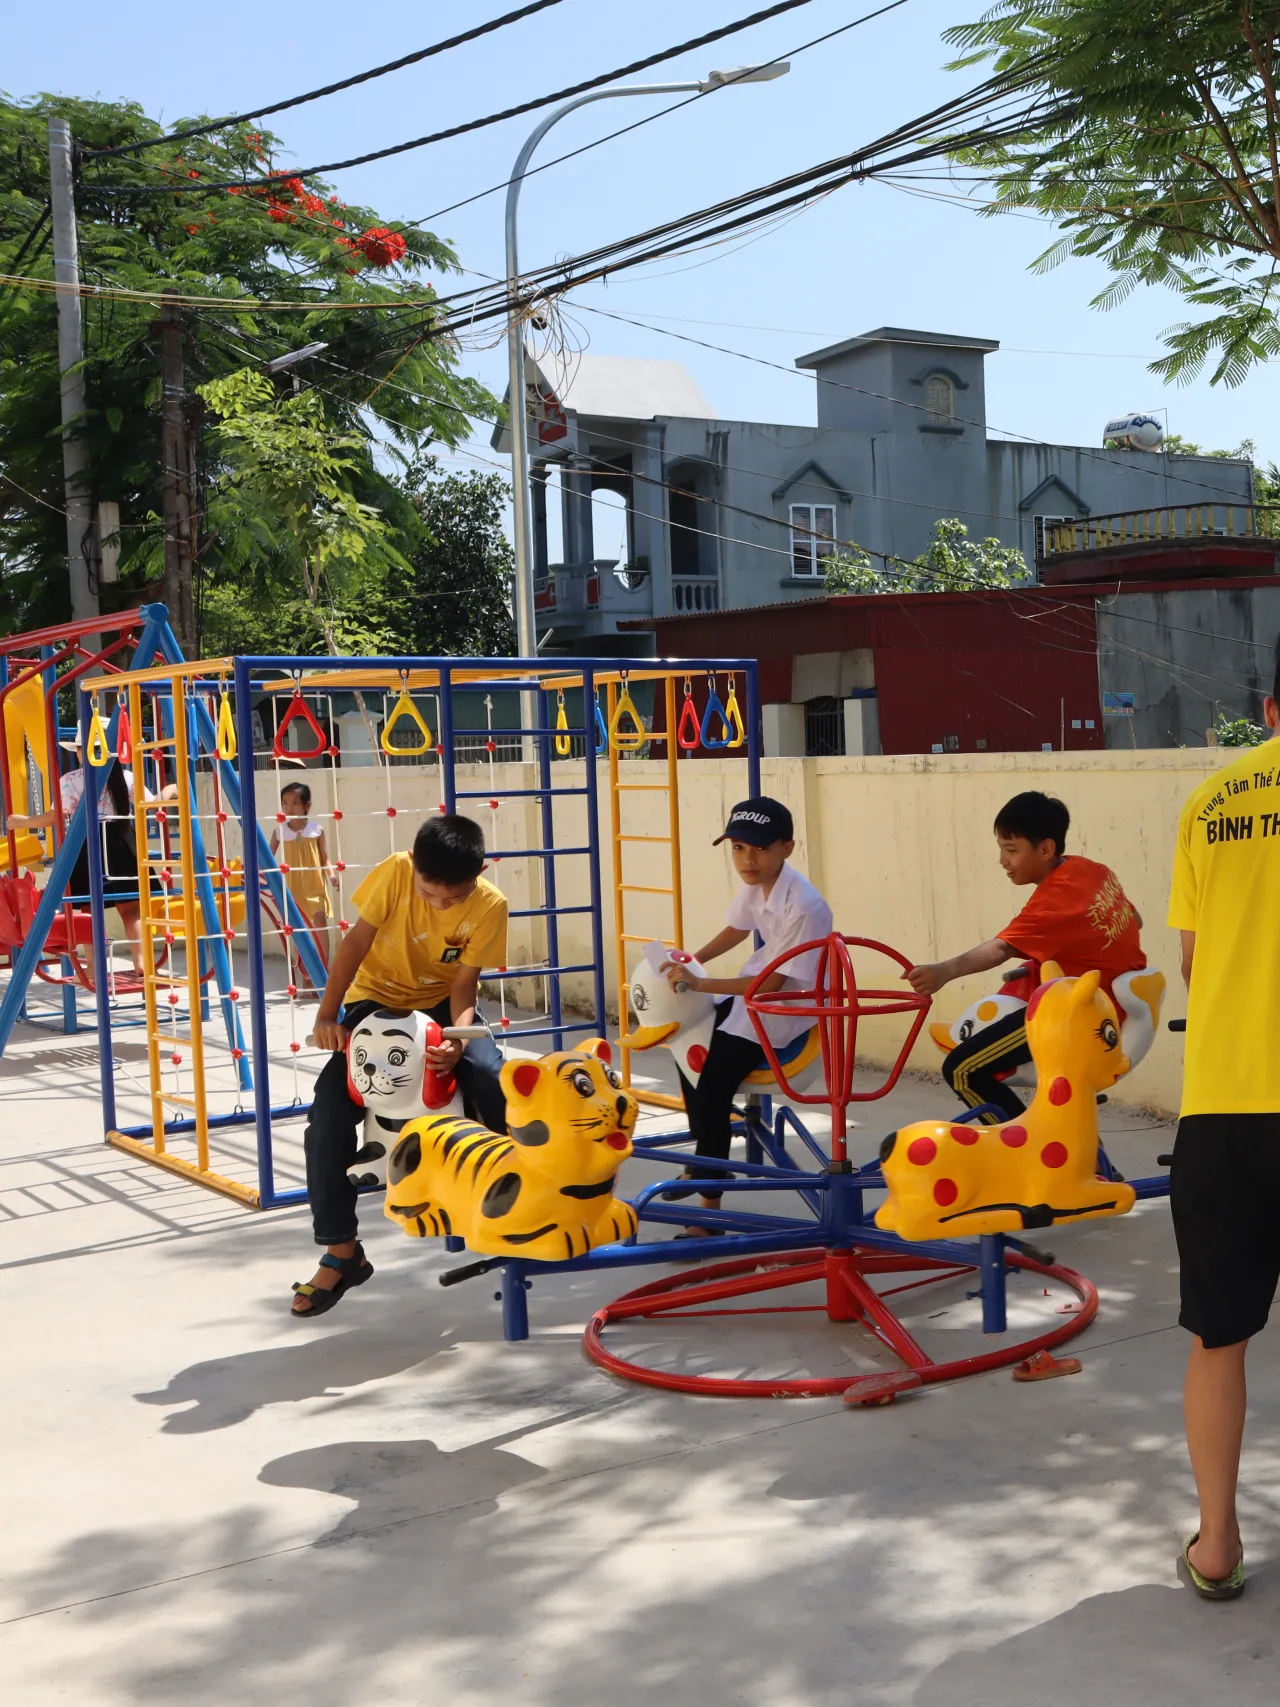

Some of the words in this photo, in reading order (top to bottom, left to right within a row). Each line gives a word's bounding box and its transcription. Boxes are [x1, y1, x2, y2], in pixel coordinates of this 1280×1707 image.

[1197, 791, 1225, 822] Trung
[1224, 779, 1249, 796] Tâm
[1253, 767, 1275, 789] Thể
[1207, 812, 1253, 845] BÌNH
